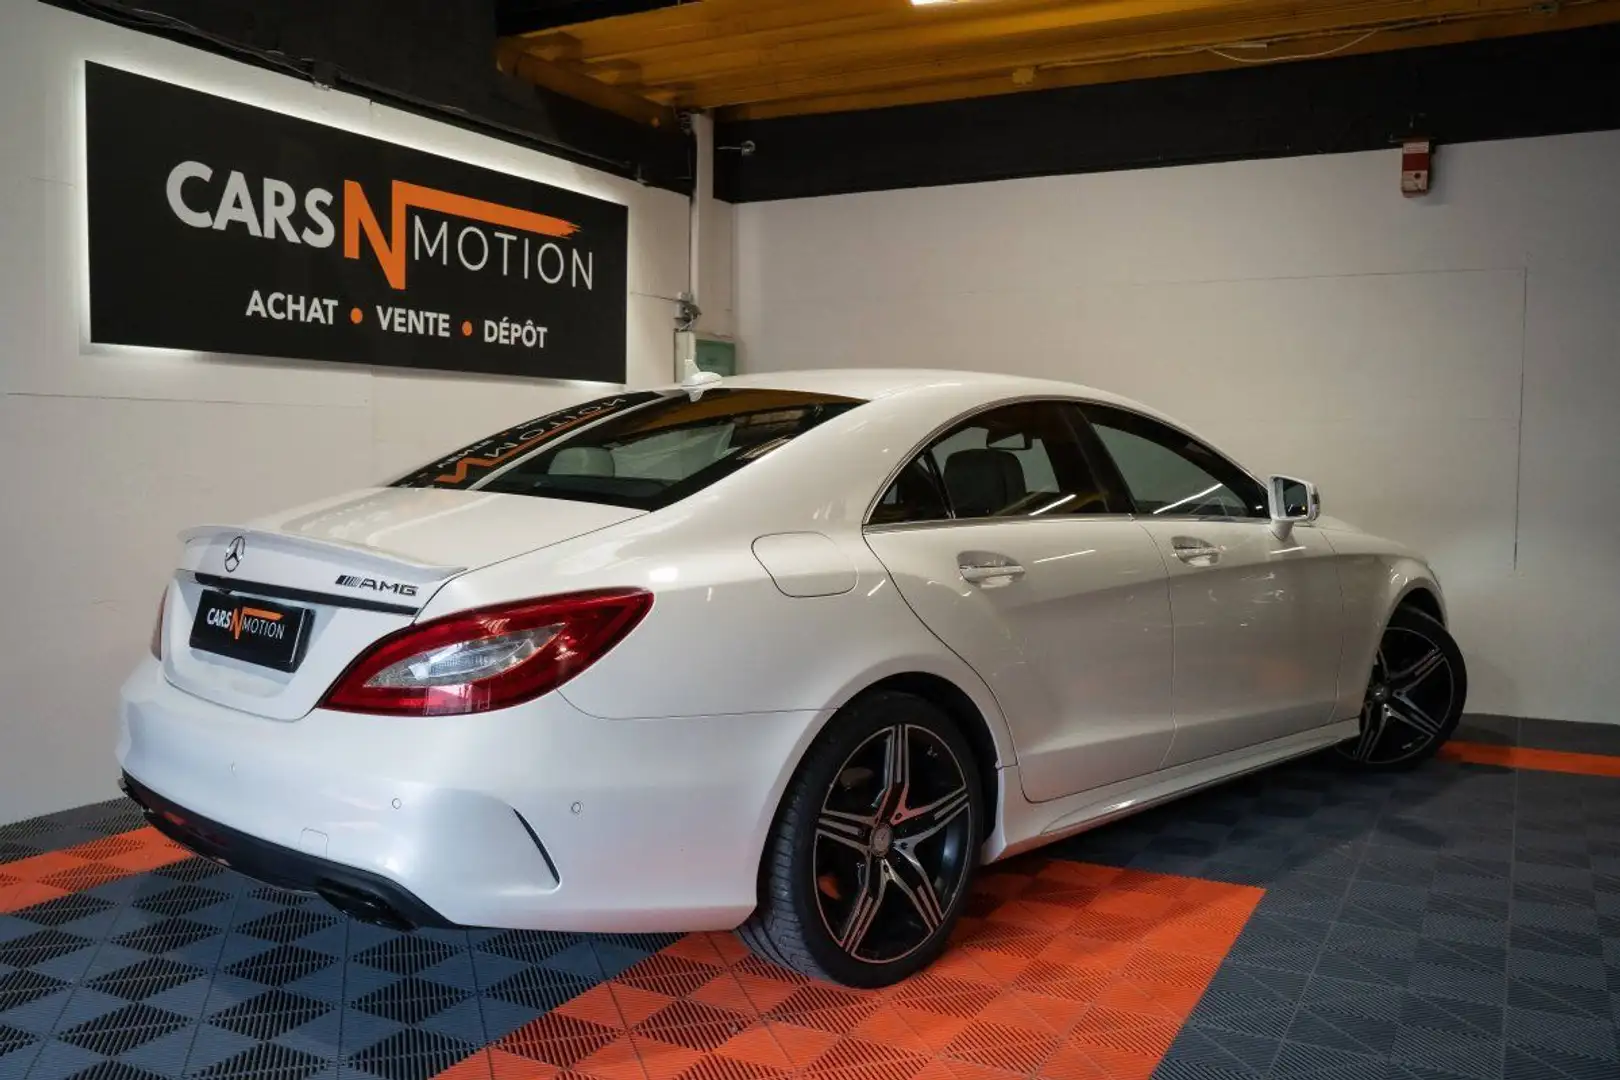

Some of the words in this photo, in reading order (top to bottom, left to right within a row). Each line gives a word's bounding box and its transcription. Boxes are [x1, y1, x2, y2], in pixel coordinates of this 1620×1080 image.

[166, 160, 335, 249] CARS
[414, 215, 593, 290] MOTION
[246, 290, 339, 326] ACHAT
[376, 305, 451, 337] VENTE
[484, 316, 547, 349] DÉPÔT
[359, 579, 418, 597] AMG
[207, 608, 231, 628] CARS
[243, 617, 285, 640] MOTION
